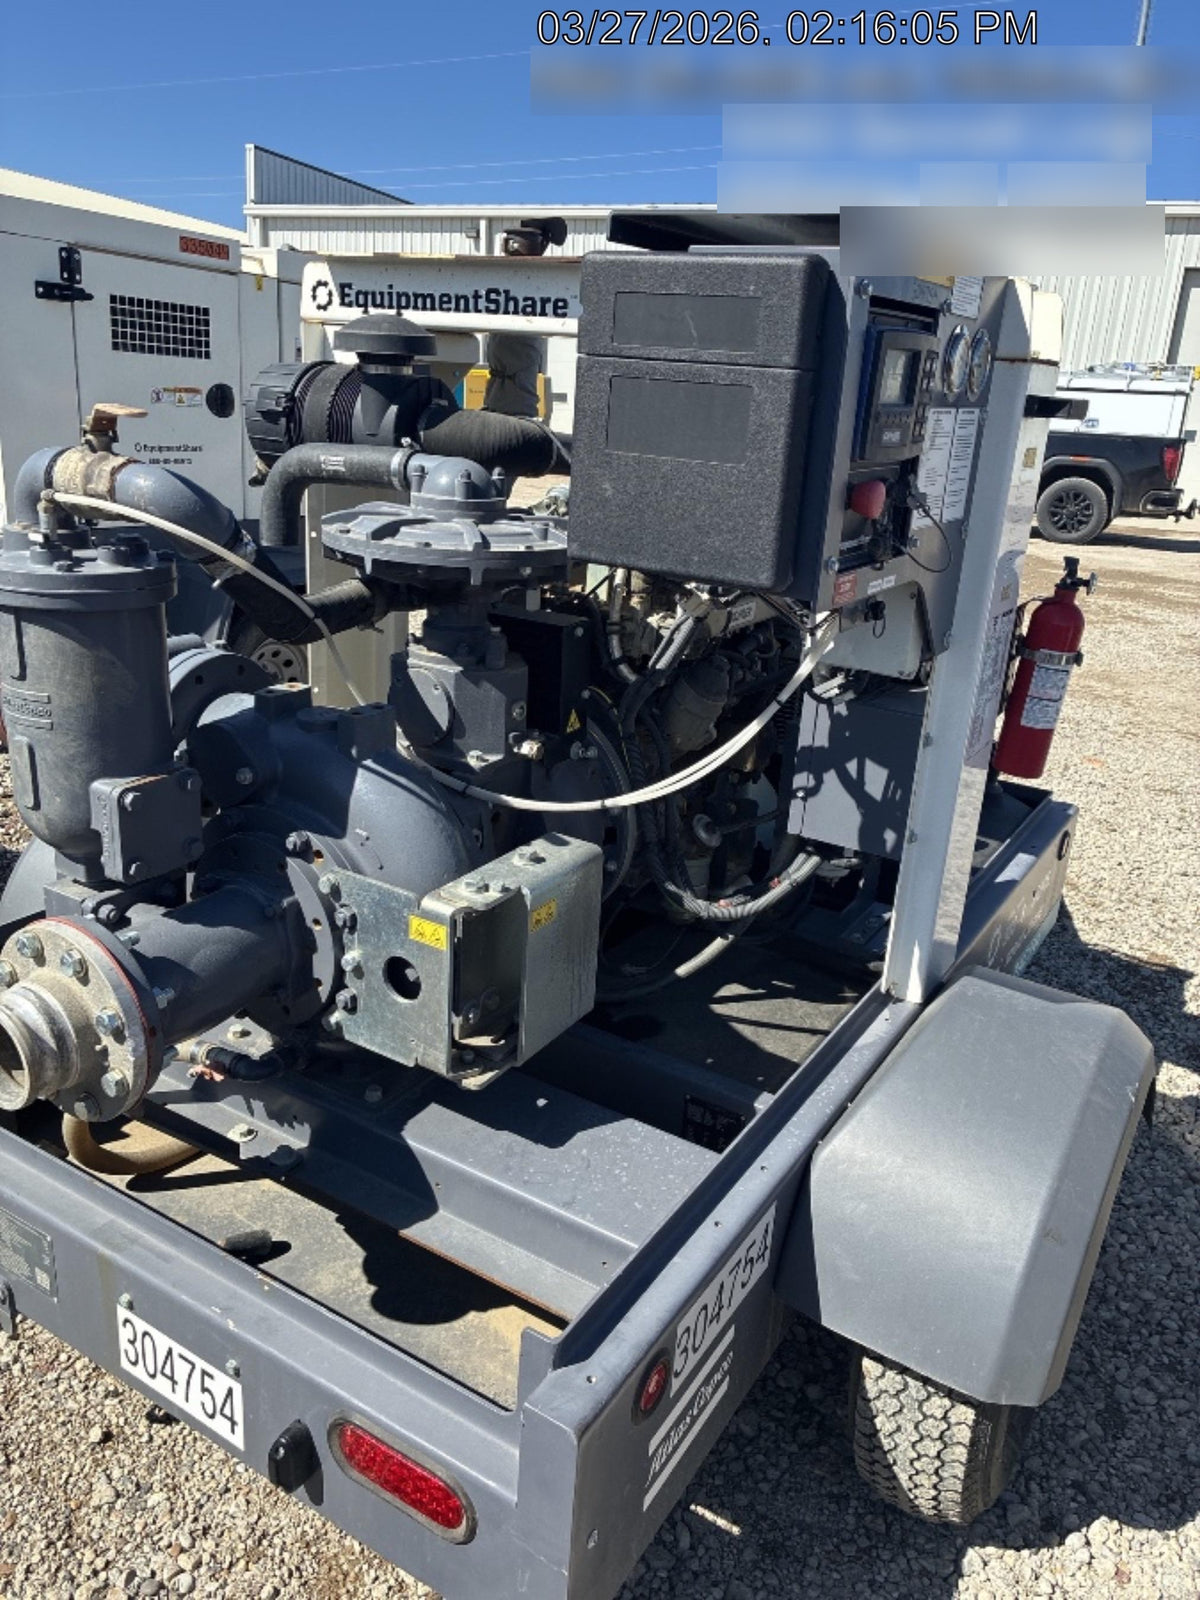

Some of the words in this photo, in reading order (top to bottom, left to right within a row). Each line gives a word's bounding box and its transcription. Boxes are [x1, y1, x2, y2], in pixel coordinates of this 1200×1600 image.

[339, 283, 568, 318] EquipmentShare
[673, 1226, 770, 1379] 304754
[122, 1318, 239, 1435] 304754
